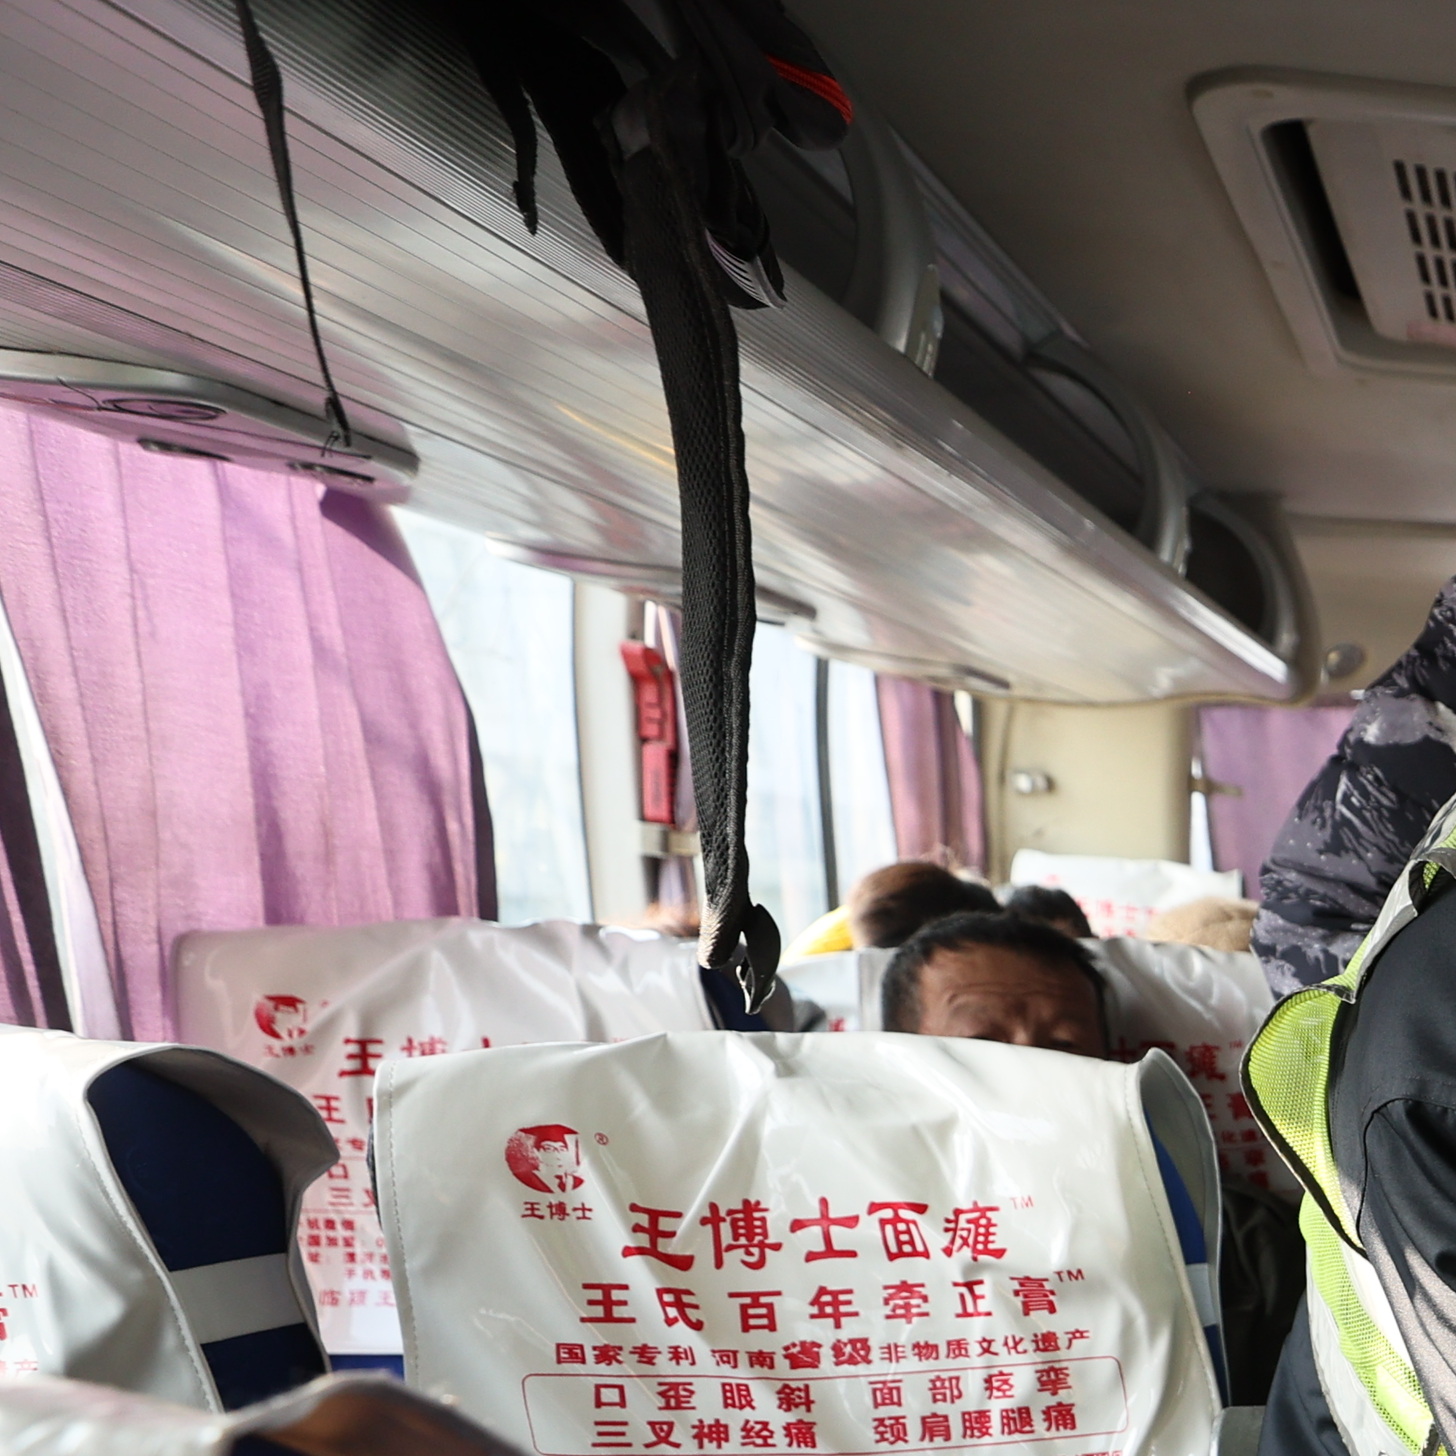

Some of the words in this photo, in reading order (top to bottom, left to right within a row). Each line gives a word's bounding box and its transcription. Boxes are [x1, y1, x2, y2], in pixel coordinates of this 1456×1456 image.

[520, 1200, 593, 1222] 王博士
[620, 1196, 1008, 1273] 王博士面瘫
[579, 1274, 1057, 1333] 王氏百年牵正膏
[555, 1342, 697, 1367] 国家专利
[593, 1382, 816, 1413] 口歪眼斜
[868, 1365, 1073, 1409] 面部痉挛
[591, 1419, 818, 1449] 三叉神经痛
[872, 1402, 1077, 1446] 颈肩腰腿痛
